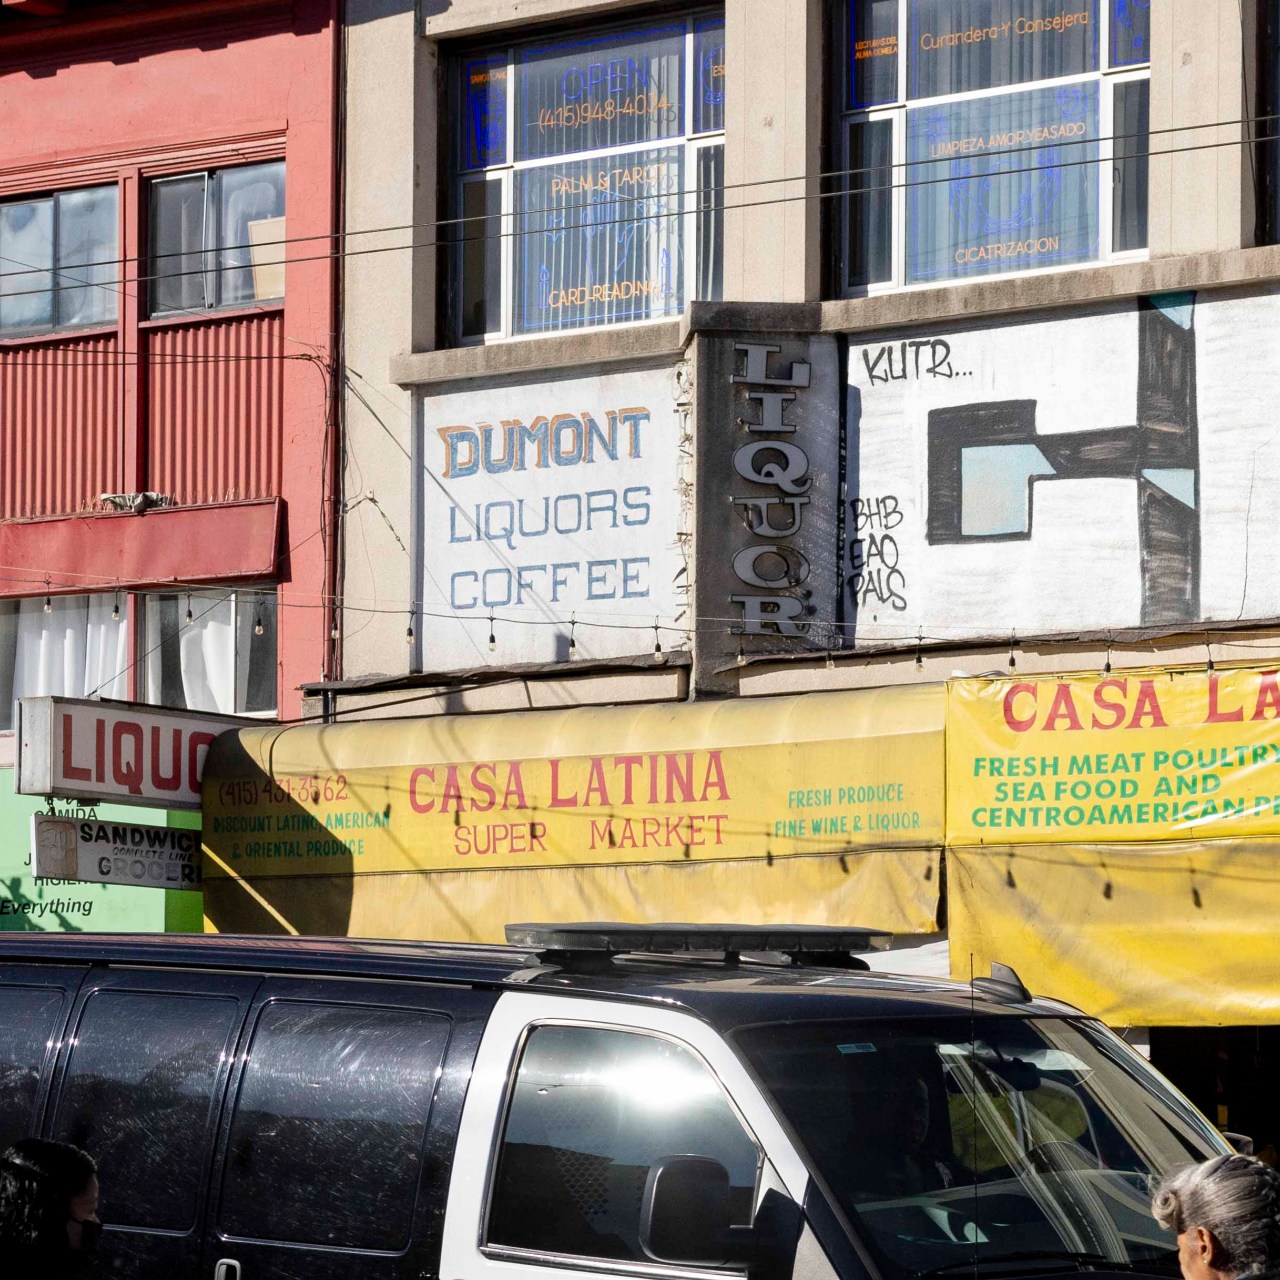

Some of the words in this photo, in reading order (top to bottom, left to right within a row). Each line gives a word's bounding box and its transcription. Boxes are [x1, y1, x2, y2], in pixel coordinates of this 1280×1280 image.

[920, 24, 999, 50] Curandera
[1014, 10, 1088, 34] Consejera
[561, 55, 648, 100] OPEN
[931, 136, 985, 158] LIMPIEZA
[988, 130, 1026, 148] AMOR
[551, 174, 593, 198] PALM
[597, 171, 609, 190] &
[955, 235, 1059, 264] CICATRIZACION
[436, 406, 652, 480] DUMONT
[730, 342, 814, 637] LIQUOR
[448, 485, 652, 551] LIQUORS
[450, 556, 651, 610] COFFEE
[1003, 678, 1169, 733] CASA
[63, 713, 217, 796] LIQUO
[973, 756, 1059, 778] FRESH
[1070, 752, 1145, 775] MEAT
[219, 781, 258, 806] (415)
[409, 760, 529, 815] CASA
[547, 750, 731, 808] LATINA
[788, 787, 832, 808] FRESH
[838, 783, 904, 805] PRODUCE
[995, 781, 1046, 803] SEA
[1055, 778, 1139, 801] FOOD
[1153, 773, 1221, 797] AND
[213, 815, 272, 834] DISCOUNT
[325, 810, 391, 831] AMERICAN
[775, 819, 807, 838] FINE
[812, 816, 847, 835] WINE
[853, 815, 863, 832] &
[869, 811, 921, 832] LIQUOR
[971, 797, 1245, 828] CENTROAMERICAN
[80, 822, 202, 851] SANDWIC
[231, 842, 242, 860] &
[245, 840, 302, 858] ORIENTAL
[306, 838, 364, 857] PRODUCE
[454, 822, 548, 856] SUPER
[588, 815, 729, 851] MARKET
[112, 846, 165, 860] COMPLETE
[168, 850, 193, 863] LINE
[0, 898, 94, 918] Everything
